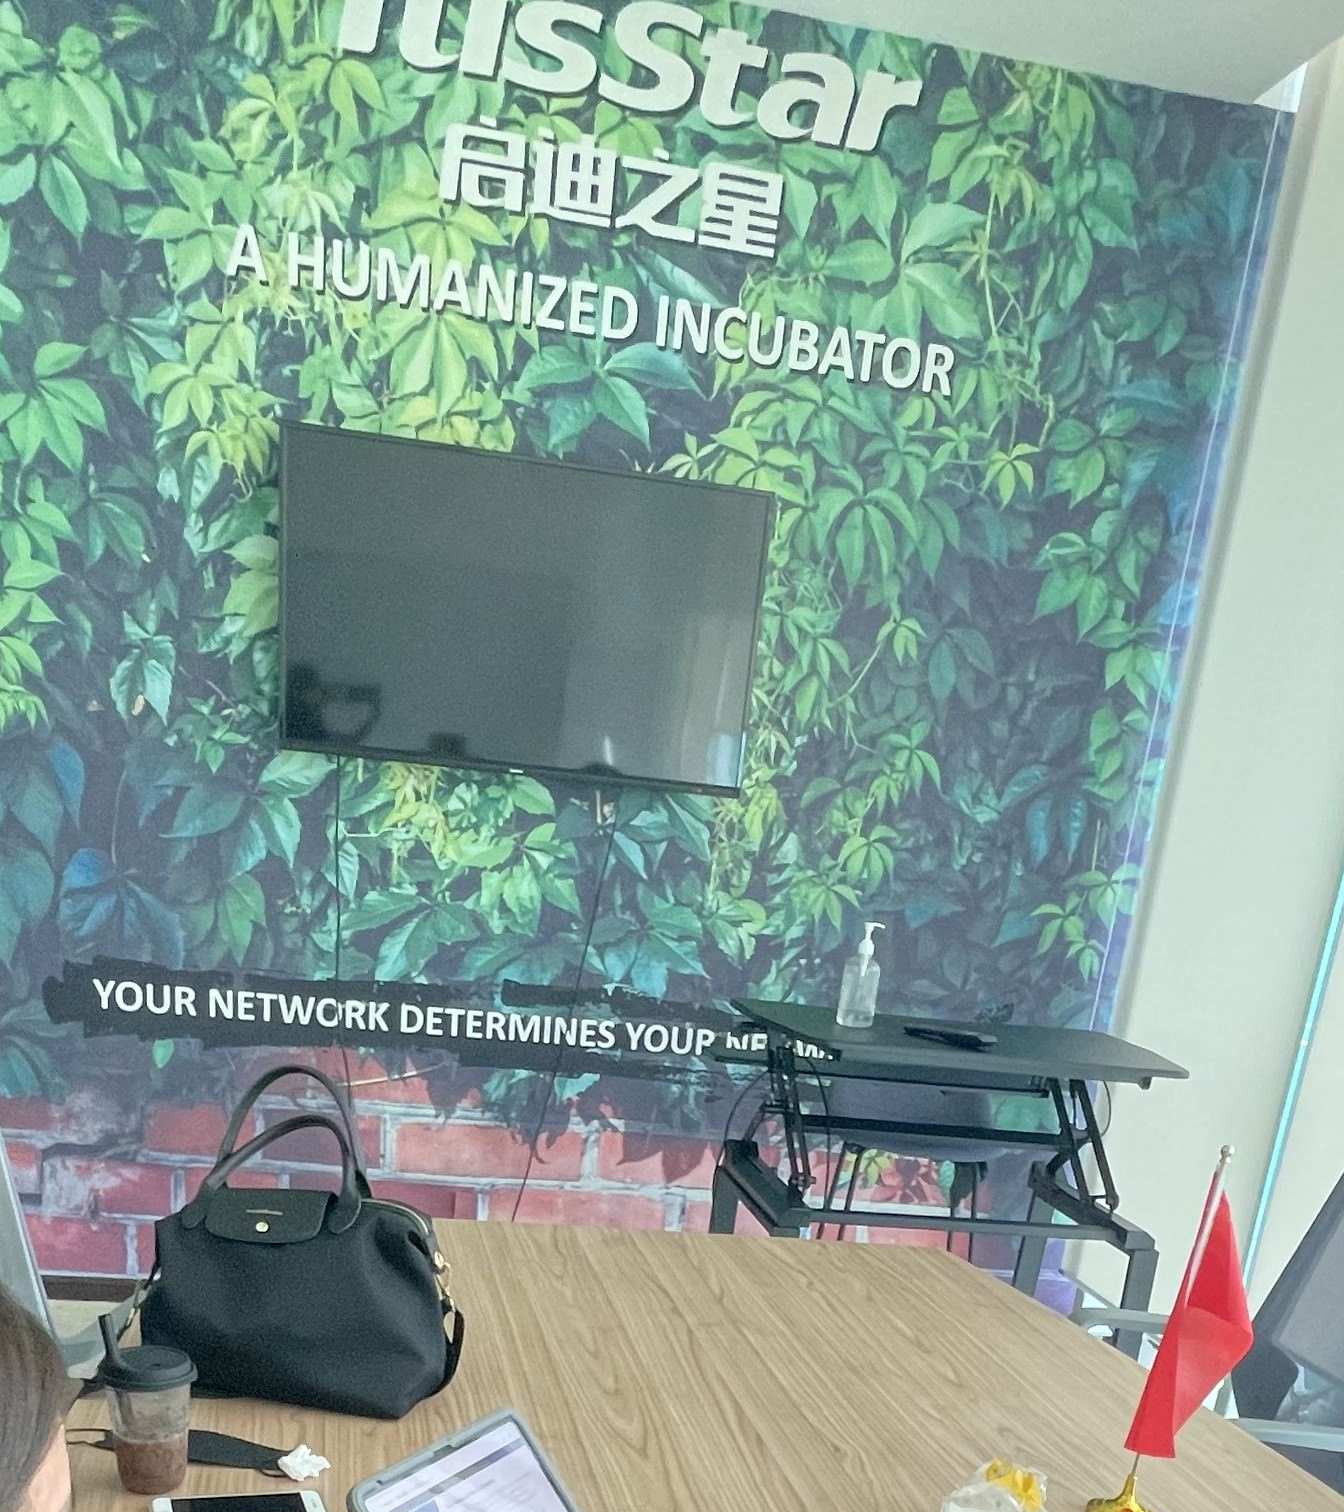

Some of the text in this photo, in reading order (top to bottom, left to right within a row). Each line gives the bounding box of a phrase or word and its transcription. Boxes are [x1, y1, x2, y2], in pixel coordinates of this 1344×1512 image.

[439, 115, 784, 259] 启迪之星
[226, 223, 955, 396] A HUMANIZED INCUBATOR
[92, 978, 197, 1017] YOUR
[209, 989, 389, 1032] NETWORK
[400, 1003, 616, 1049] DETERMINES
